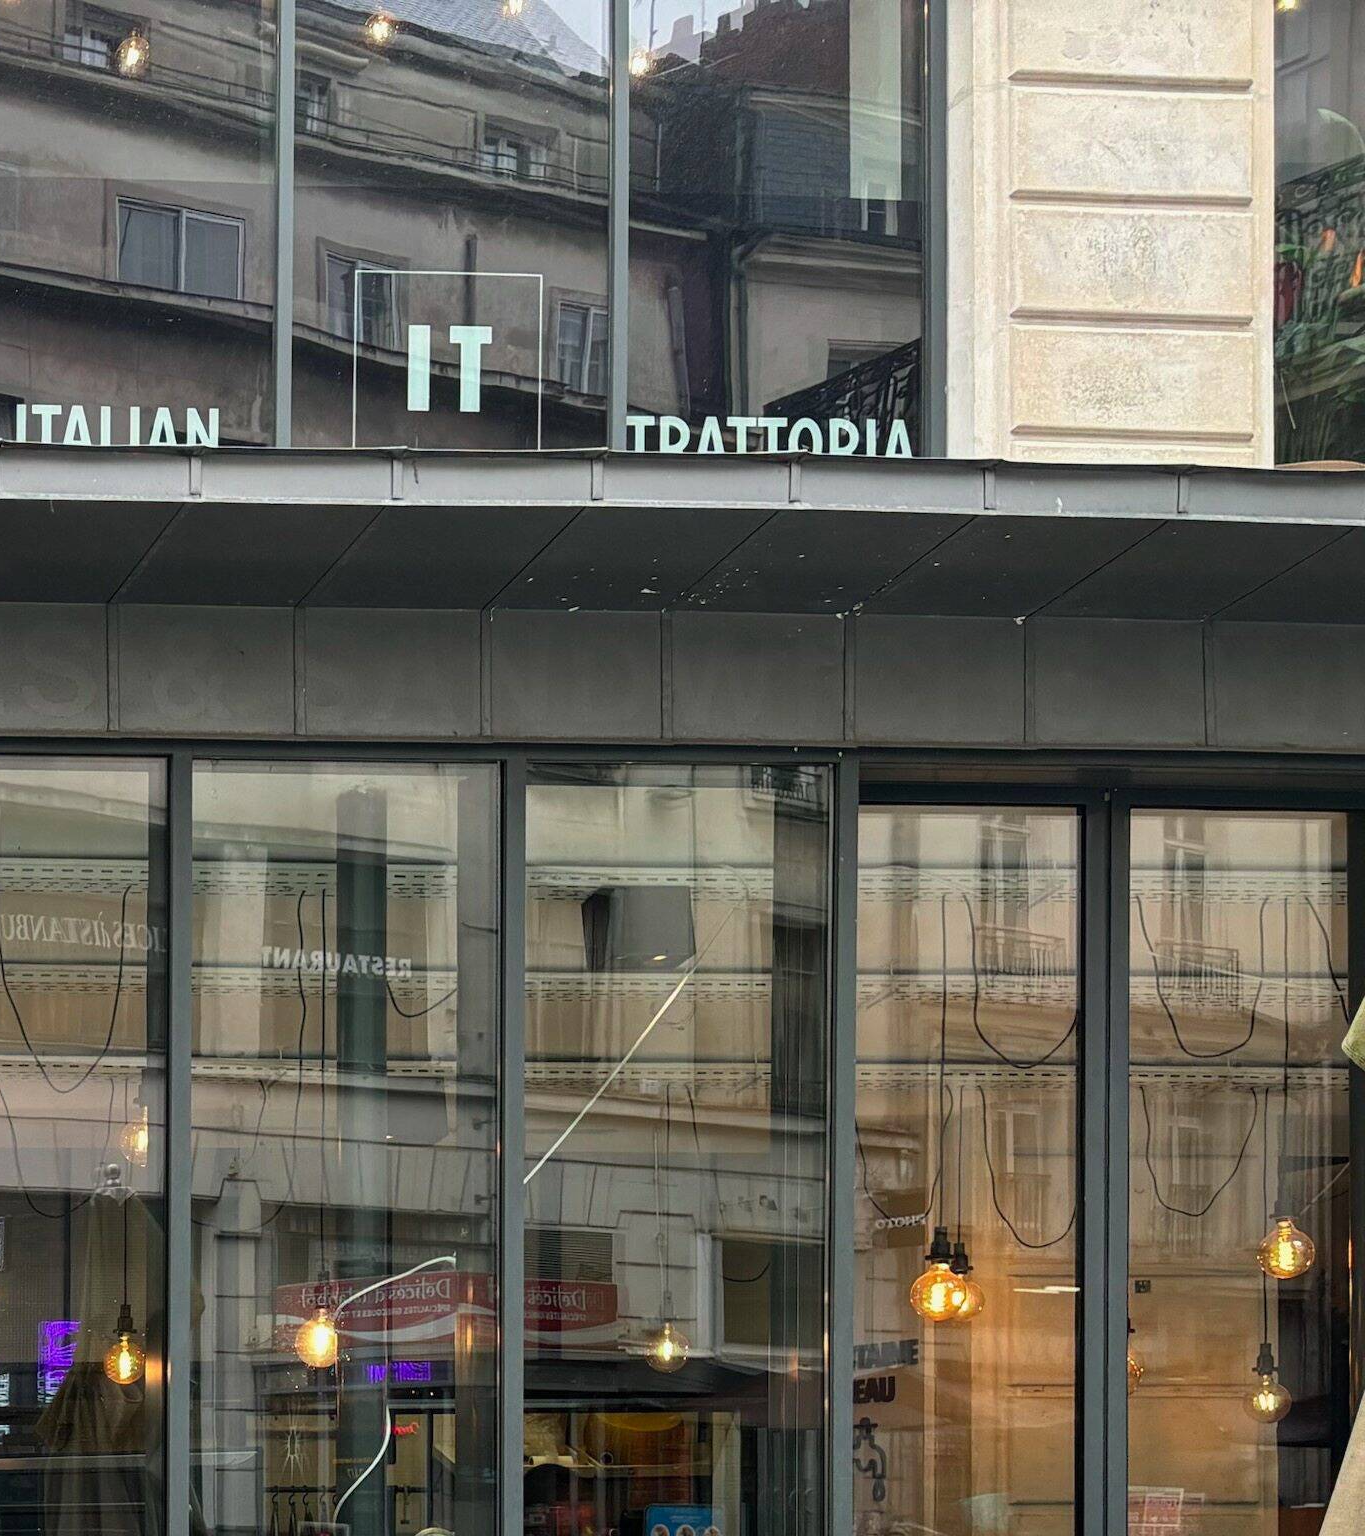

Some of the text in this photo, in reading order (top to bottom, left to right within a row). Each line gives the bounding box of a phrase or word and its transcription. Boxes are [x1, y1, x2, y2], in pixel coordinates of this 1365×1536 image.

[406, 323, 493, 413] IT
[15, 403, 220, 449] ITALIAN
[625, 414, 913, 459] TRATTORIA
